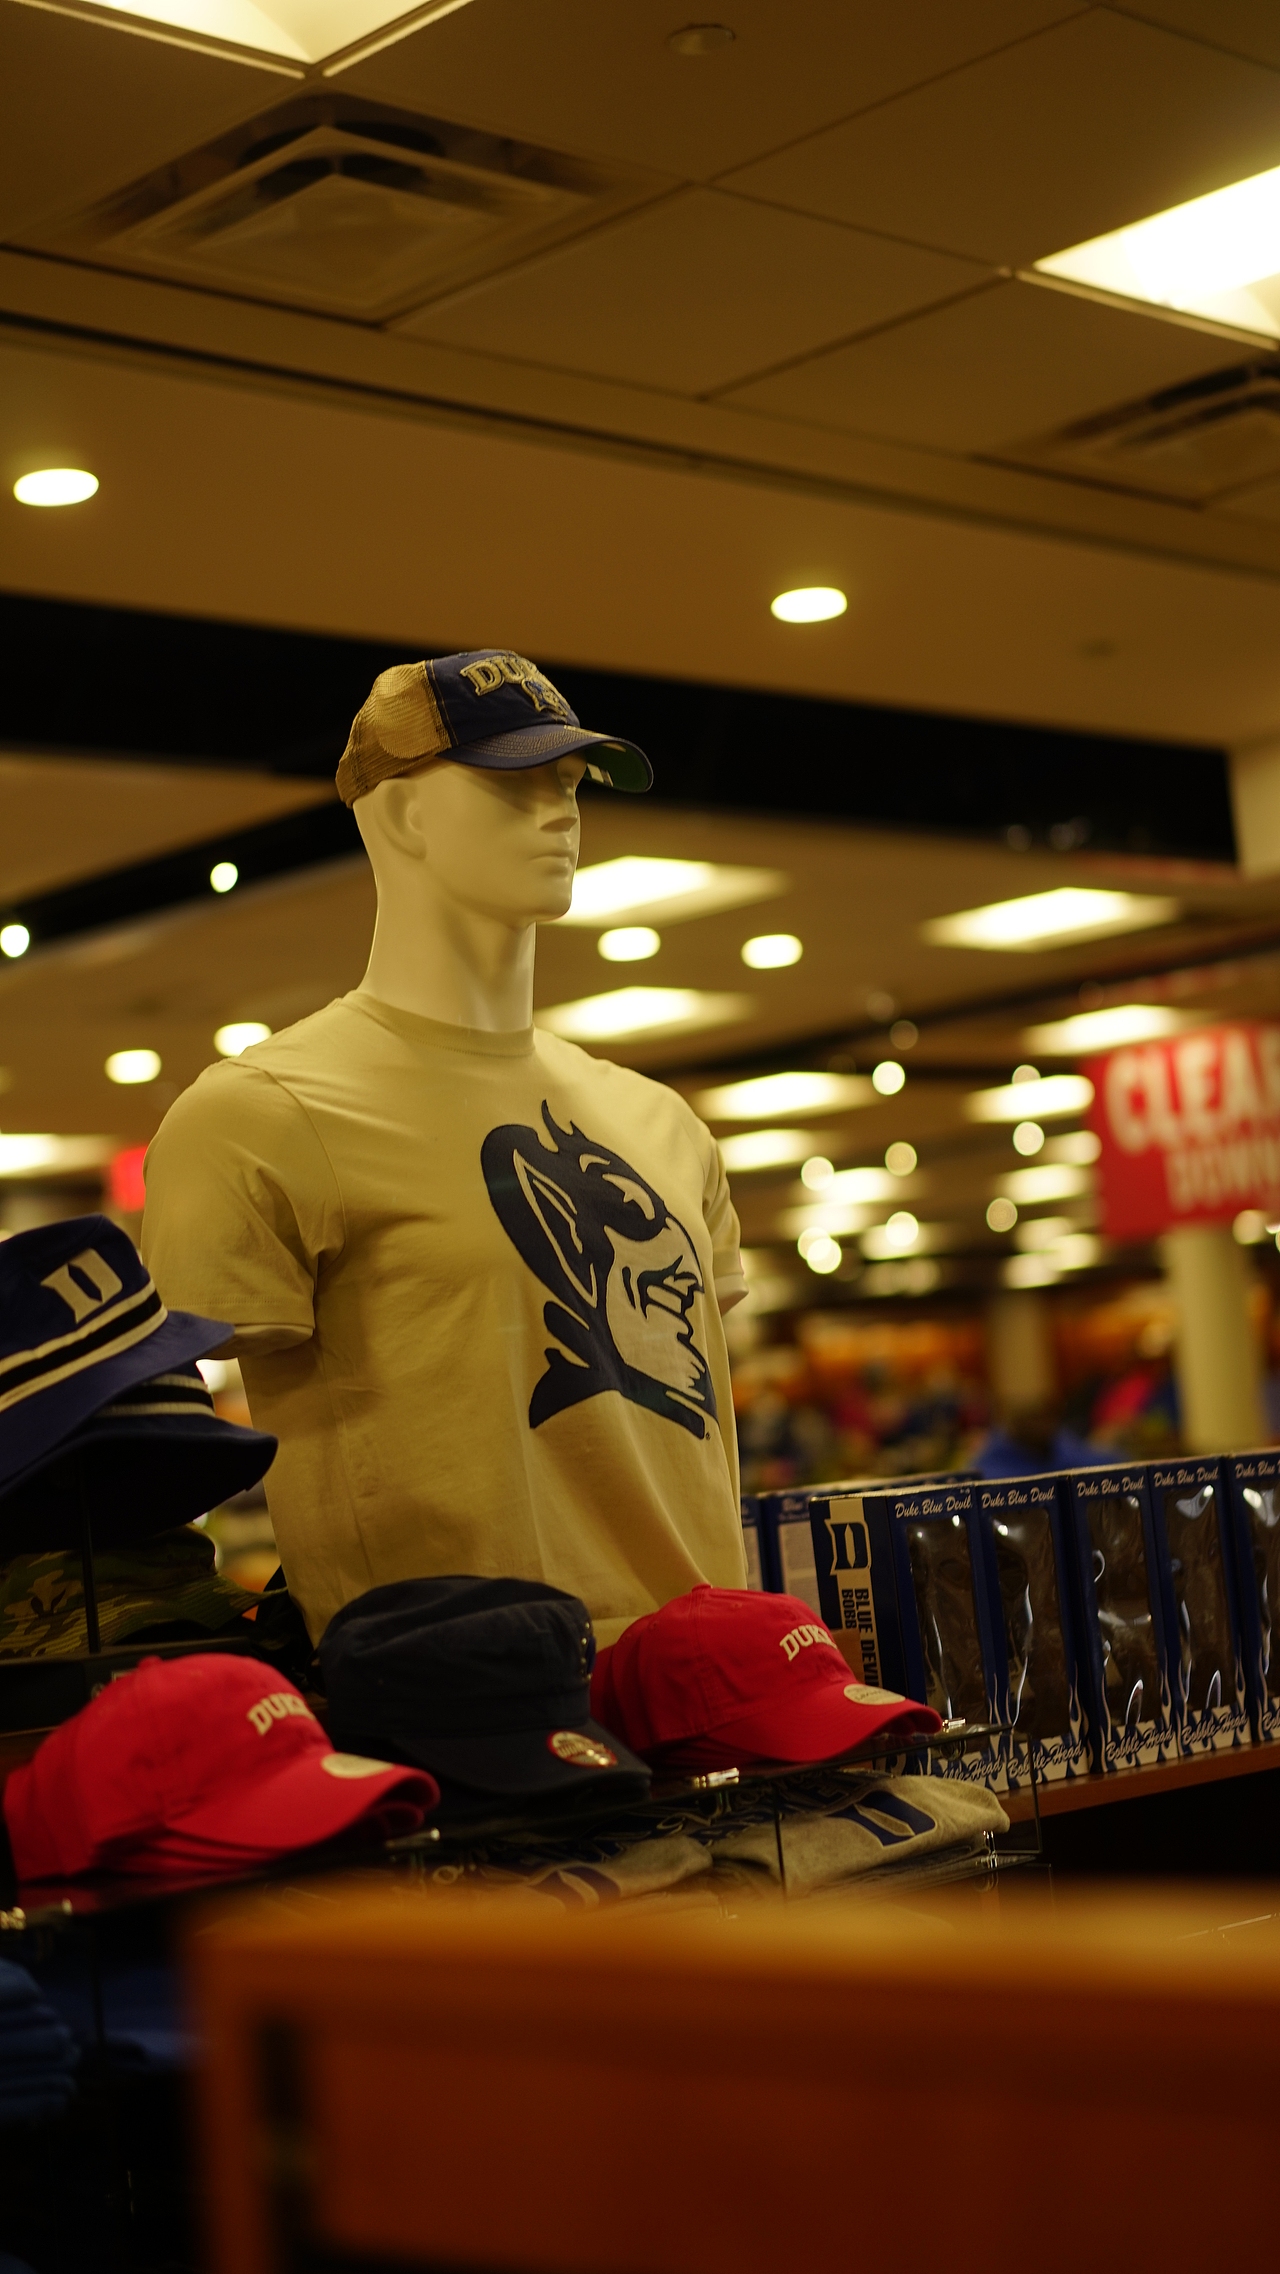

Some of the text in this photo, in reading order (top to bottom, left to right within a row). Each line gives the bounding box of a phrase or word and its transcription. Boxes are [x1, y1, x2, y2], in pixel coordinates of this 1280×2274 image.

[40, 1247, 124, 1325] D
[1153, 1466, 1219, 1488] Duke Blue Devil
[1235, 1460, 1276, 1479] Duke Blue
[981, 1485, 1055, 1510] Duke Blue Devil
[1076, 1475, 1144, 1498] Duke Blue Devil
[894, 1494, 972, 1519] Duke Blue Devil
[829, 1520, 871, 1572] D
[854, 1588, 875, 1634] BLUE
[1105, 1724, 1174, 1759] Bobble-Head
